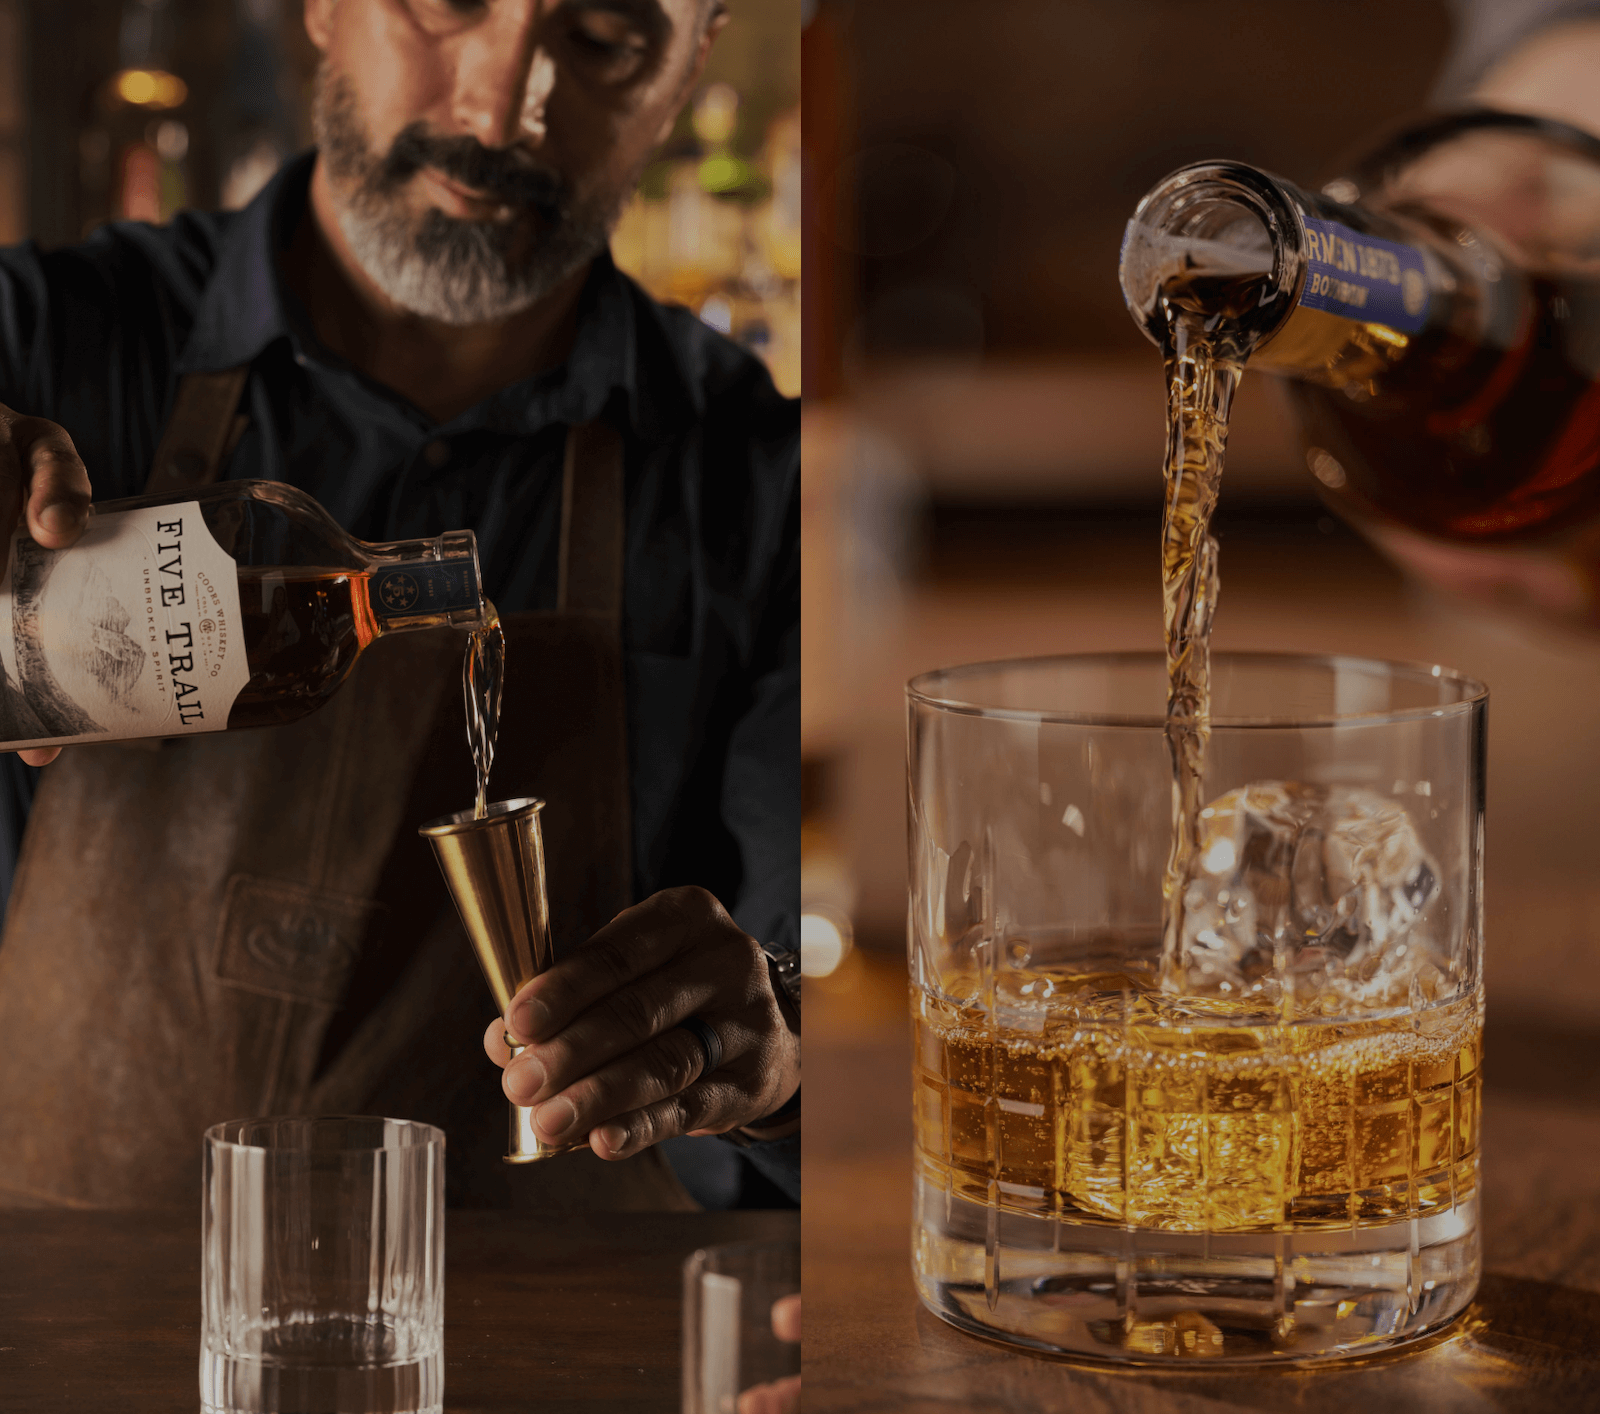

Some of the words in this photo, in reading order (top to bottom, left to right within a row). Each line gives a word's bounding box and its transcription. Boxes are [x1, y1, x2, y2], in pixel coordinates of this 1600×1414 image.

[157, 518, 185, 607] FIVE
[143, 568, 157, 642] UNBROKEN
[152, 651, 165, 692] SPIRIT
[197, 572, 220, 606] COORS
[216, 608, 227, 661] WHISKEY
[165, 622, 204, 725] TRAIL
